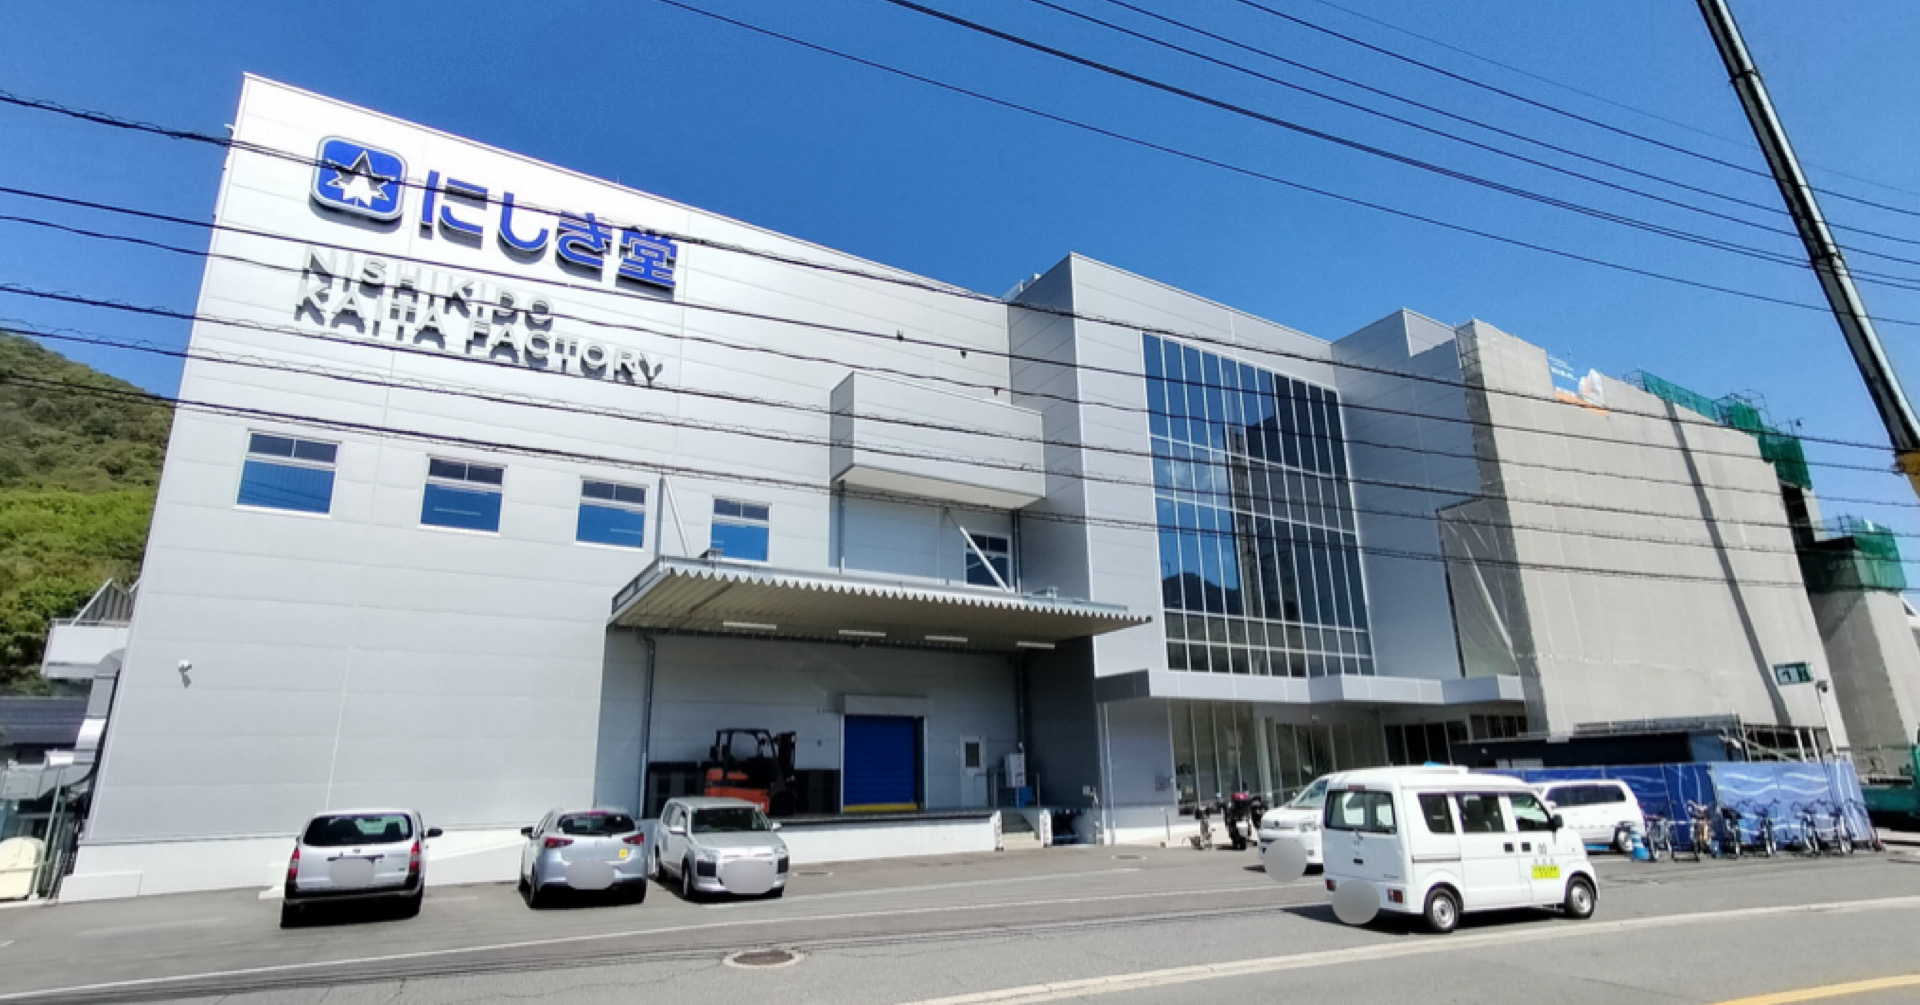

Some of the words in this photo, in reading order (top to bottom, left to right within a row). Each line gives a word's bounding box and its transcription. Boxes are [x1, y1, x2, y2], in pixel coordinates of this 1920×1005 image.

[301, 245, 553, 324] NISHIKIDO
[421, 170, 678, 288] にしき堂
[297, 270, 447, 338] KAITA
[467, 311, 664, 381] FACTORY
